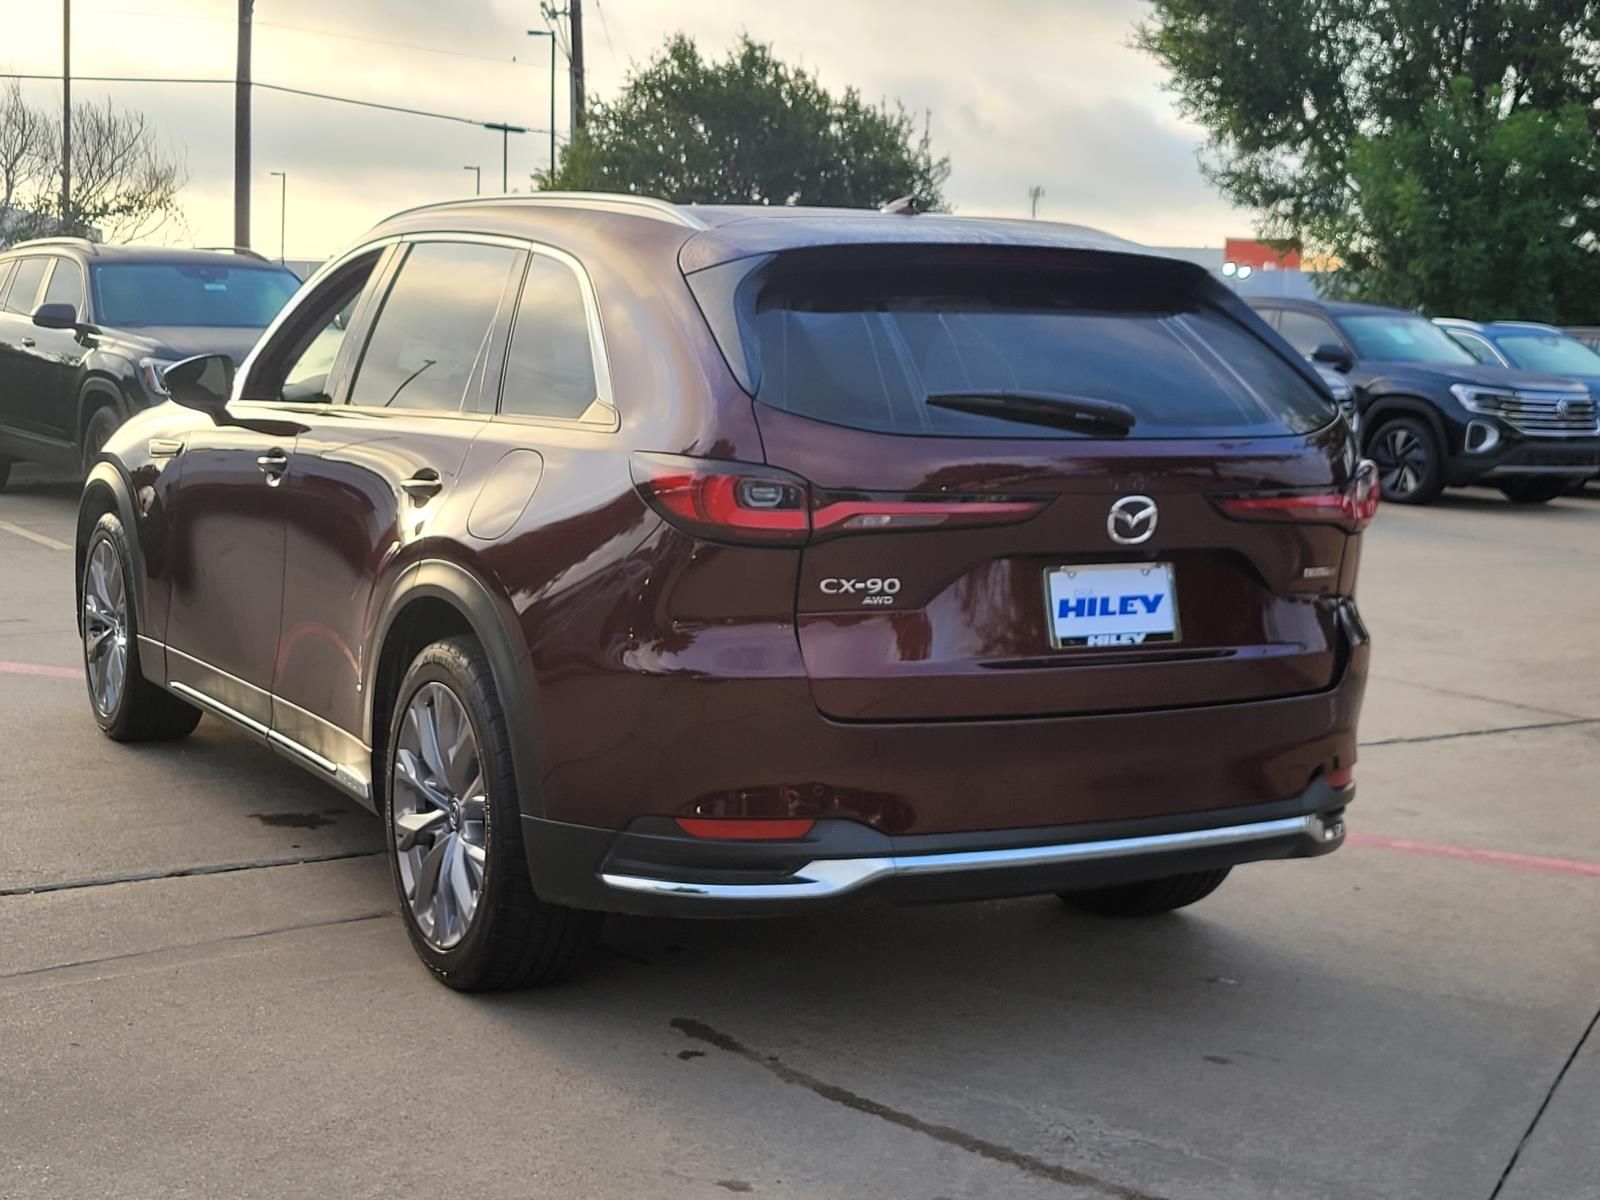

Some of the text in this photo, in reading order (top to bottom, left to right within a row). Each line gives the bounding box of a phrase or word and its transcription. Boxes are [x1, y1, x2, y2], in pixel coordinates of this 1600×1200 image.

[820, 578, 901, 594] CX-90
[862, 595, 894, 605] AWD
[1058, 593, 1164, 618] HILEY
[1087, 631, 1147, 647] HILEY
